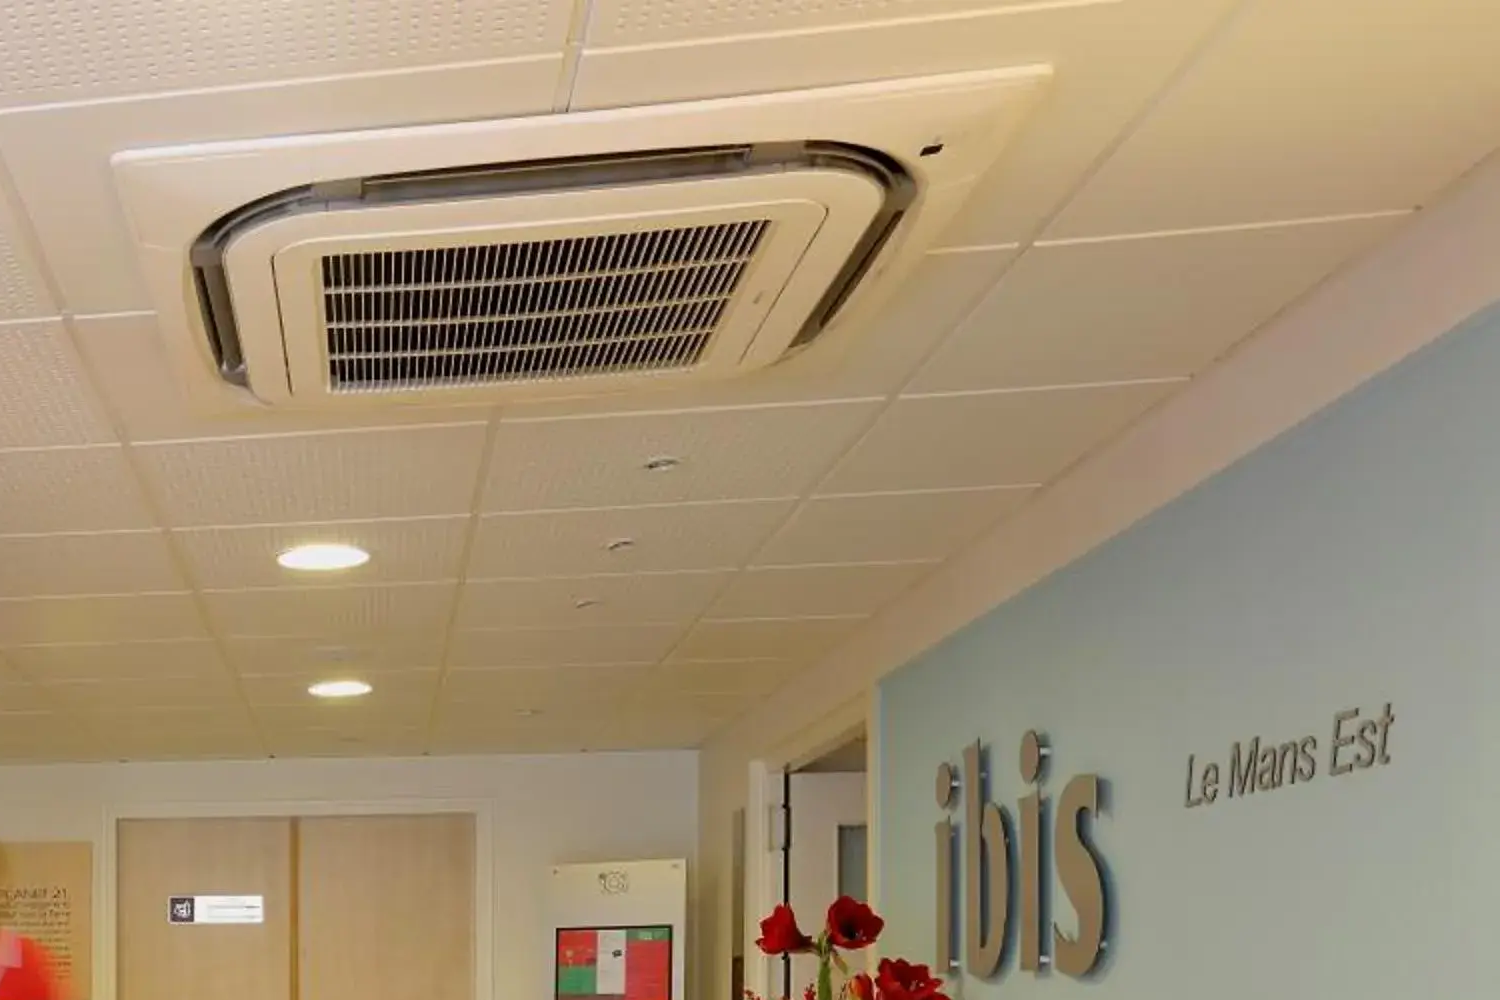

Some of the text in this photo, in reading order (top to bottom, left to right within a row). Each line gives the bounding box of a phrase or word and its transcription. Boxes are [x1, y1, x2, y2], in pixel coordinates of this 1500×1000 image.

[1184, 703, 1395, 808] Le Mans Est
[934, 729, 1108, 979] ibis
